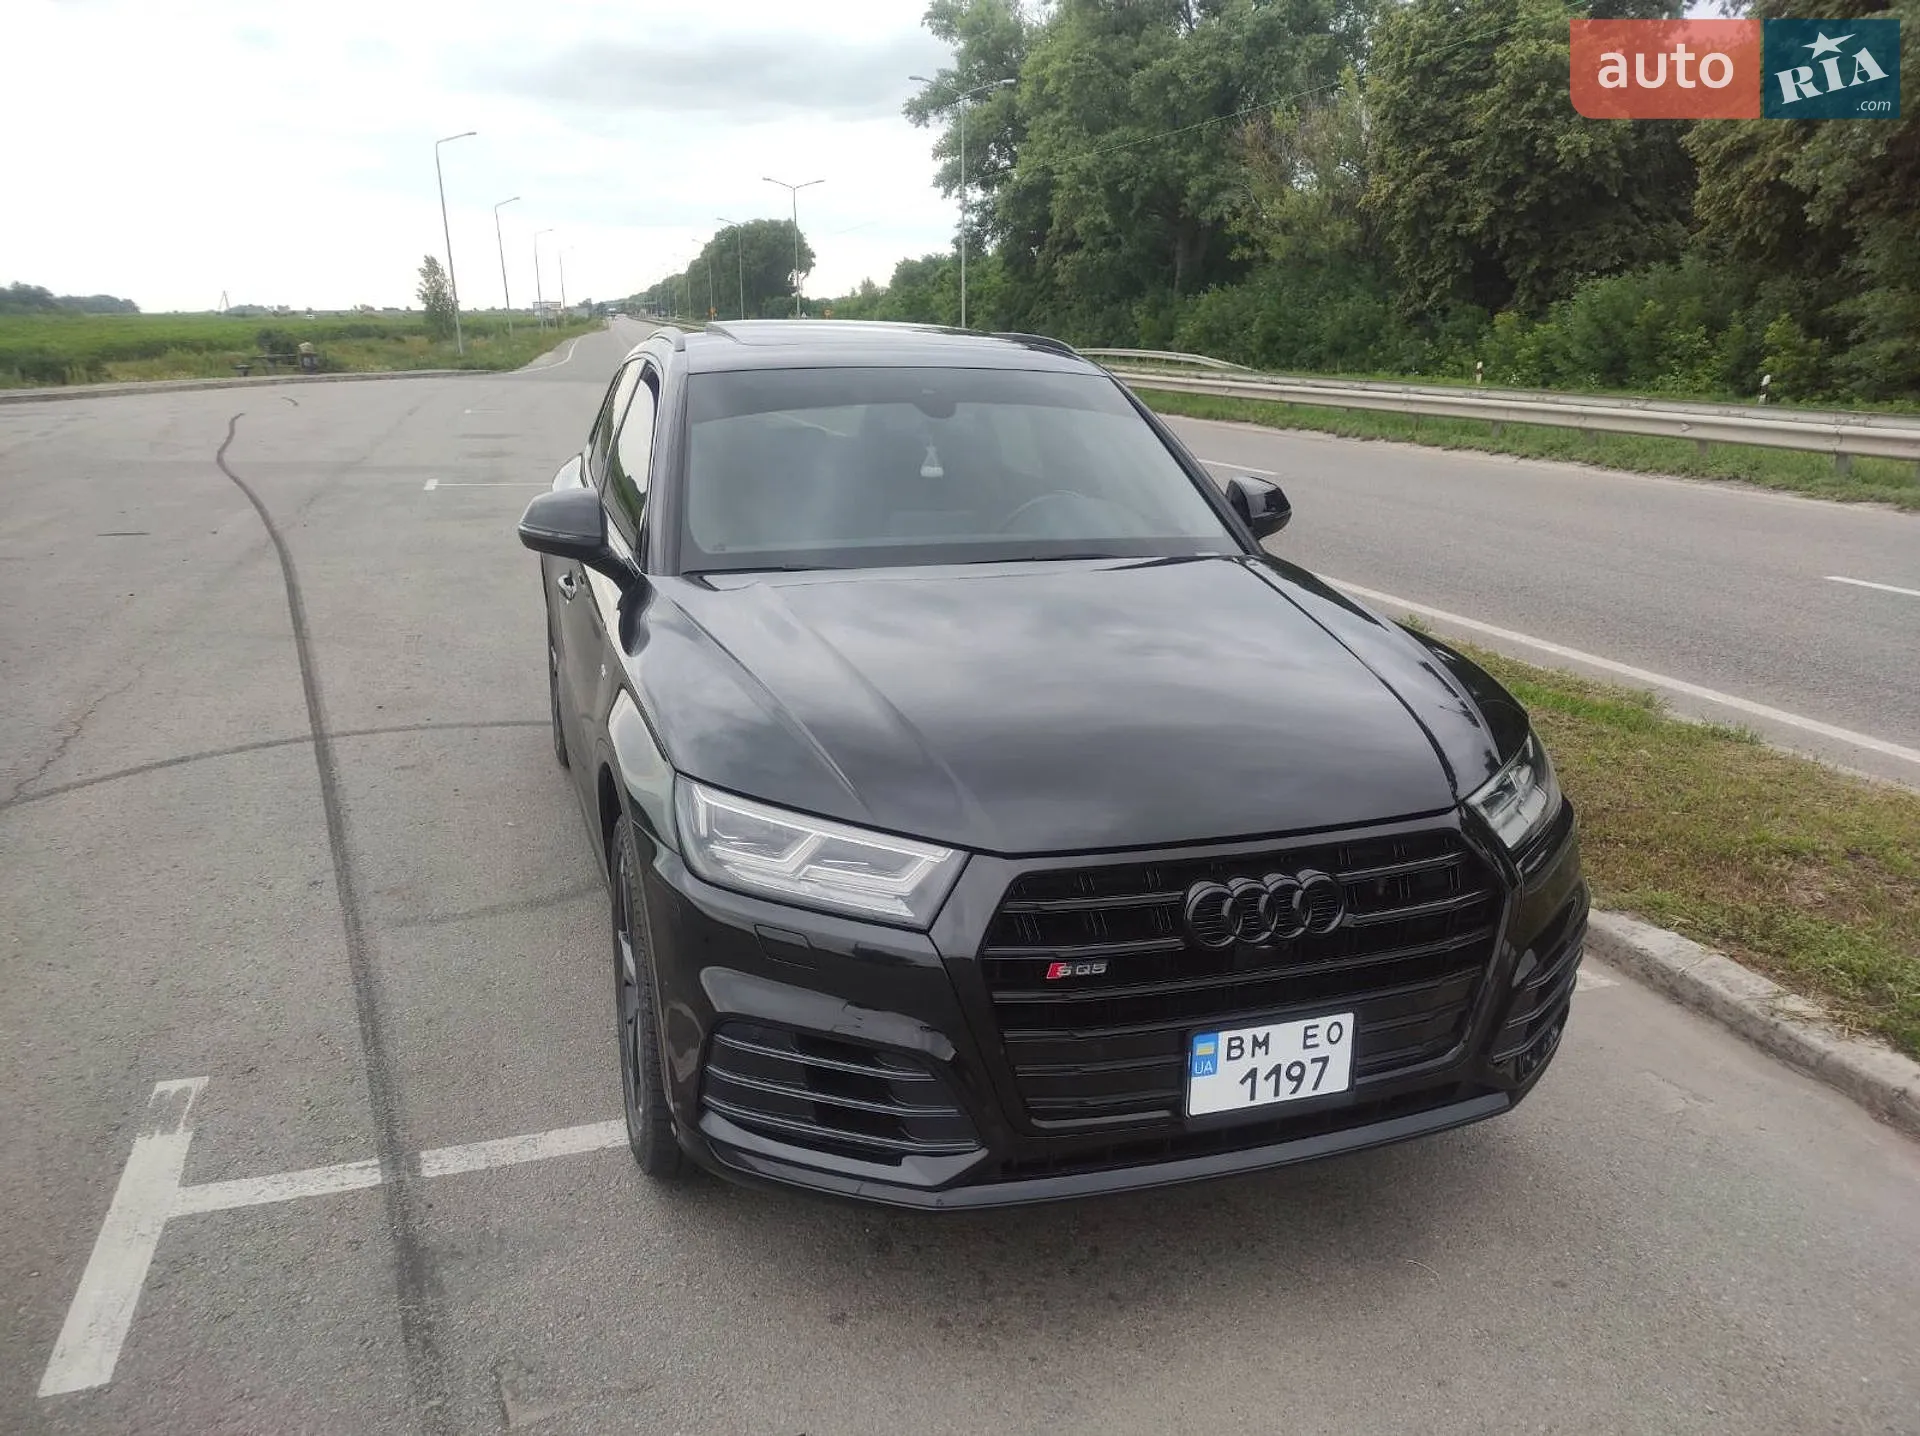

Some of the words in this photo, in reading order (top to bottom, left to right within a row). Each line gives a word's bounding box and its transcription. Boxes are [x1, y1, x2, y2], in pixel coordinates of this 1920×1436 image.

[1226, 1032, 1270, 1062] BM
[1195, 1060, 1213, 1074] UA
[1239, 1055, 1330, 1101] 1197
